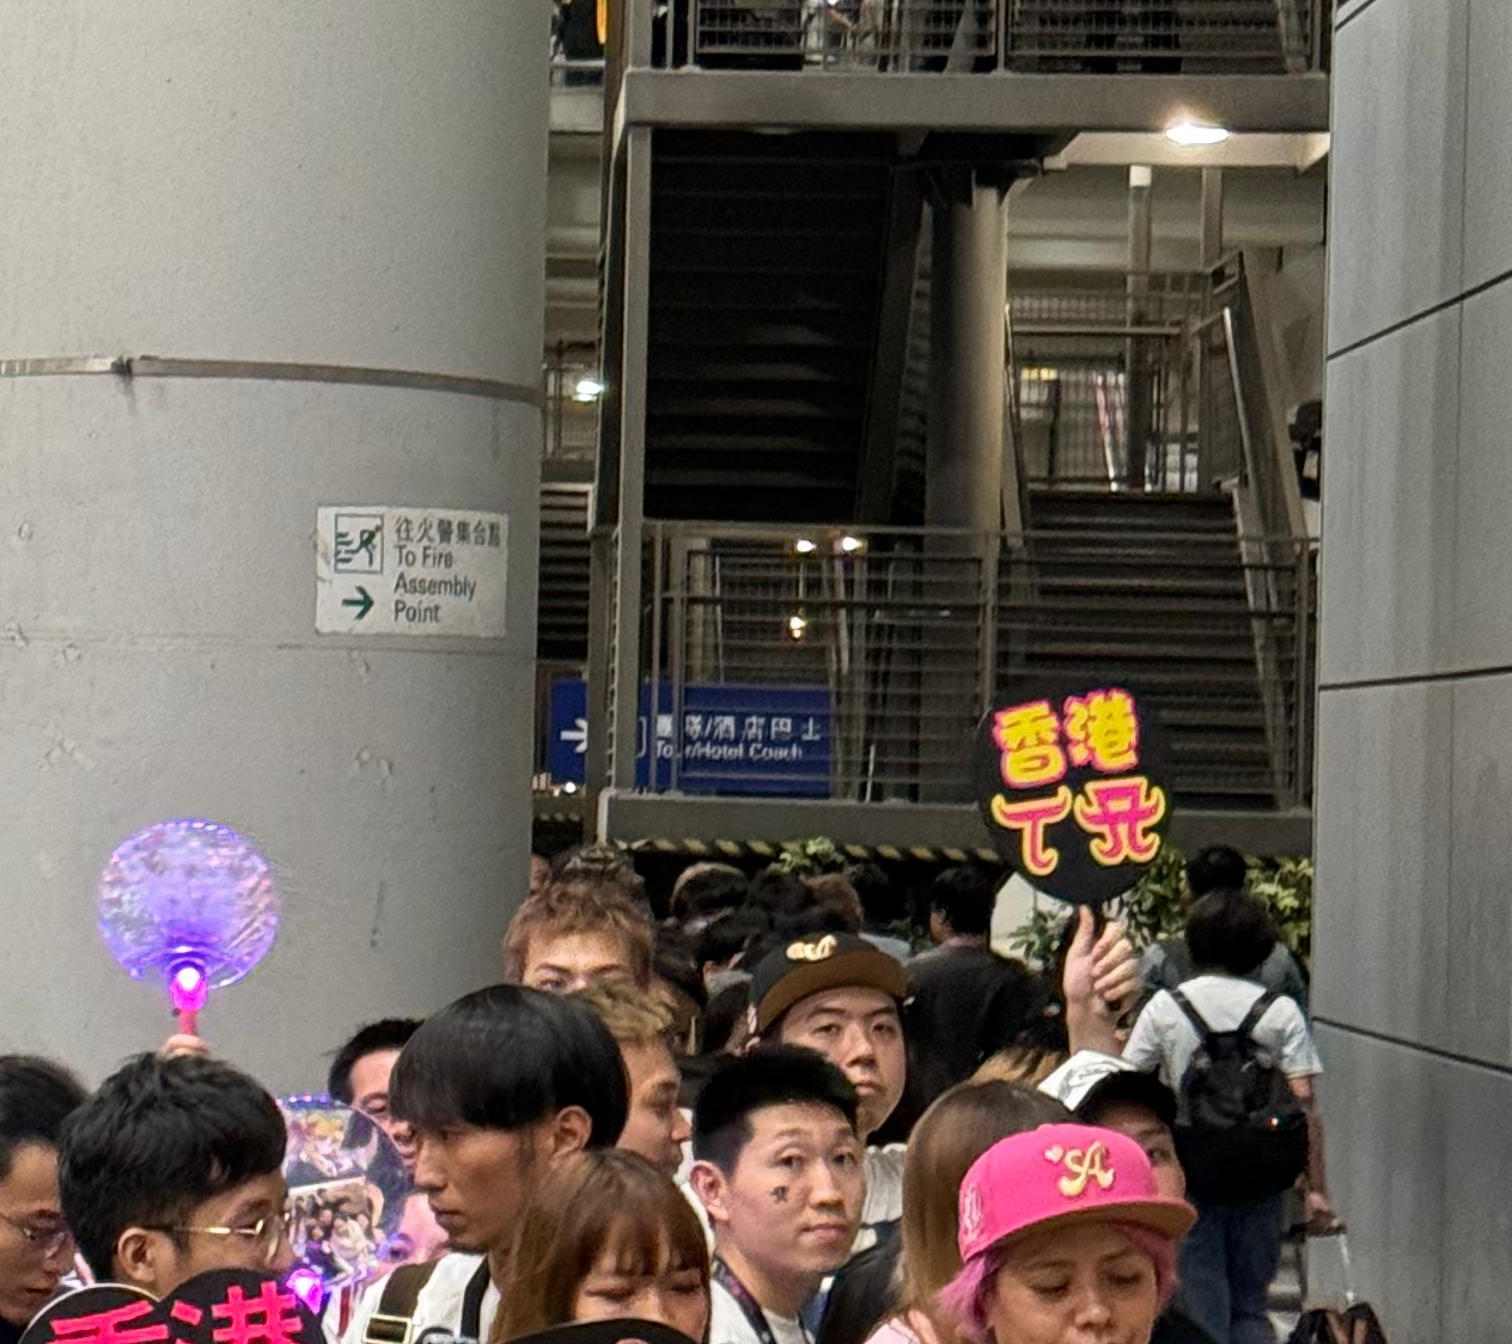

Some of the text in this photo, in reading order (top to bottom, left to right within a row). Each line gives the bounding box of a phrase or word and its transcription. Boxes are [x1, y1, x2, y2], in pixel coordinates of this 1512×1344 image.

[395, 544, 454, 569] To Fire
[394, 572, 477, 601] Assembly
[394, 599, 441, 624] Point
[992, 688, 1140, 789] 香港
